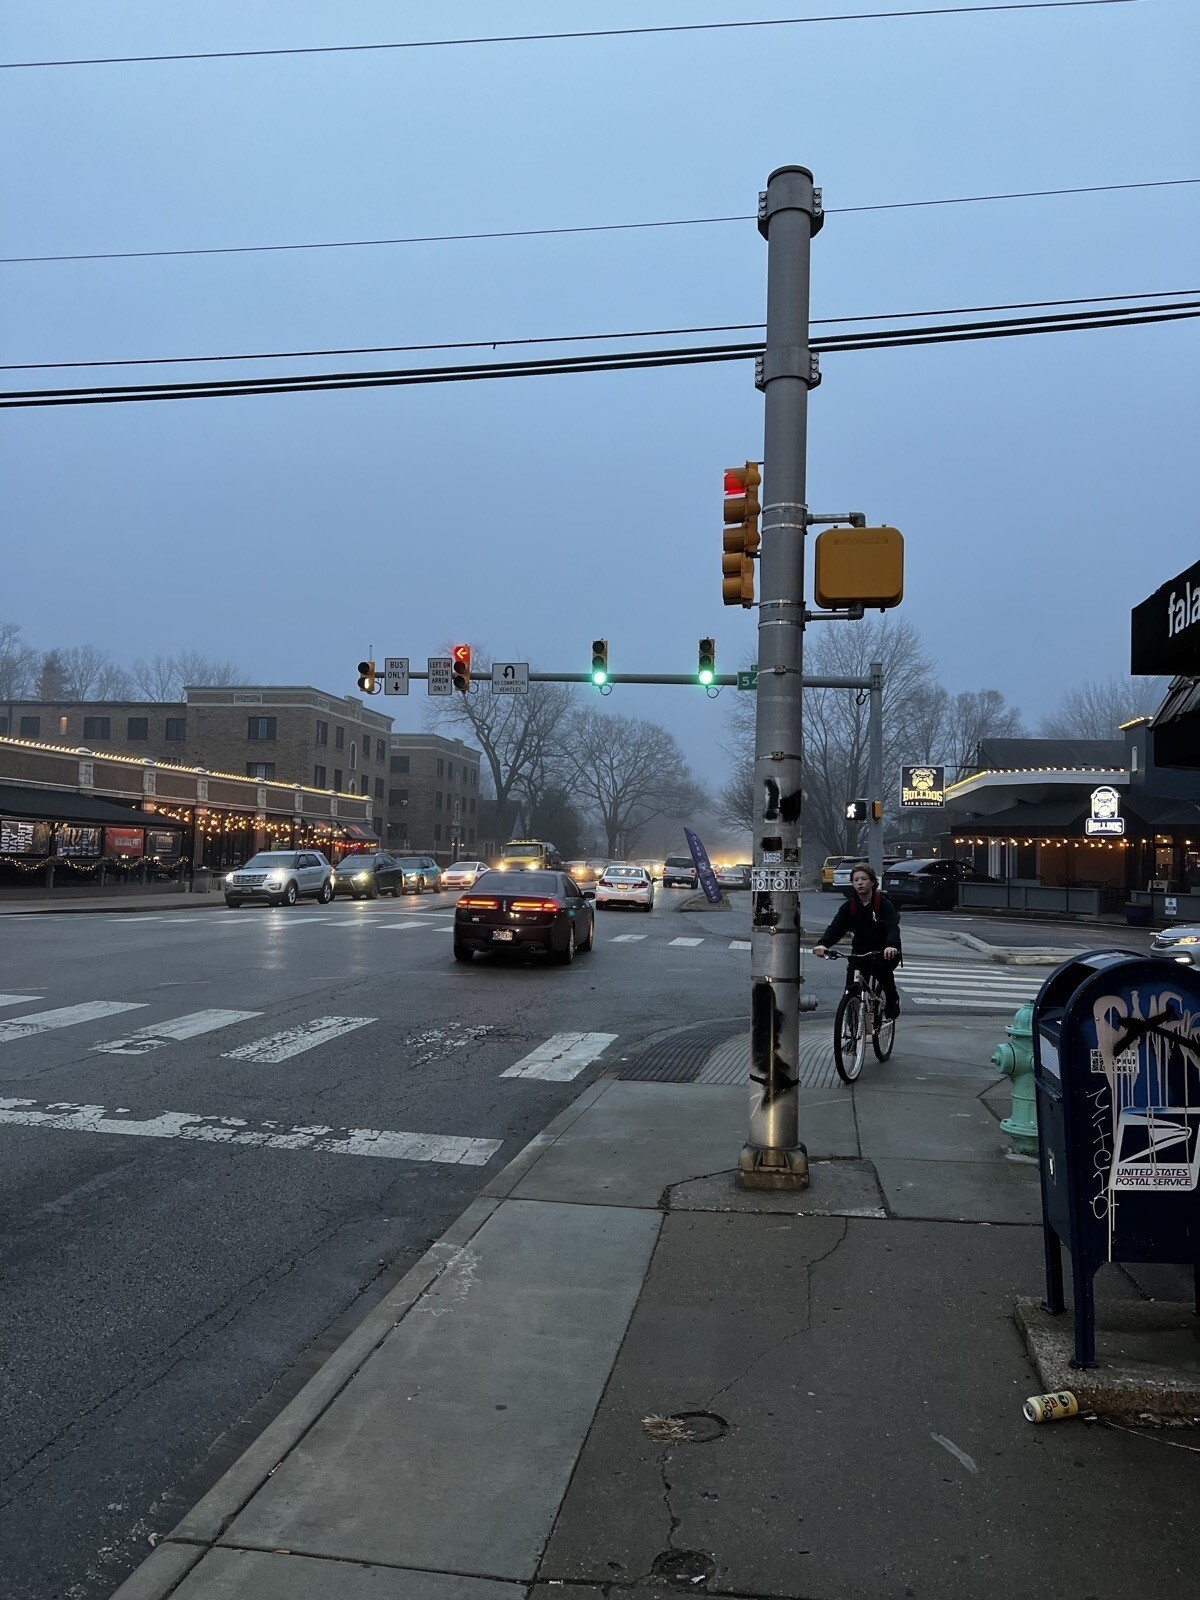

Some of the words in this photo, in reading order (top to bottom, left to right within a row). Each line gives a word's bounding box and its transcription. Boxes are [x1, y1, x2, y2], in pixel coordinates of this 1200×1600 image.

[390, 661, 403, 669] BUS
[388, 671, 406, 679] ONLY
[902, 790, 943, 802] BULLDOG
[0, 828, 11, 853] MON
[17, 822, 26, 853] NIGHT
[24, 825, 34, 845] JAM
[9, 833, 18, 853] DAY
[1116, 1168, 1152, 1176] UNITED
[1155, 1168, 1188, 1176] STATES
[1115, 1178, 1151, 1186] POSTAL
[1152, 1178, 1192, 1186] SERVICE
